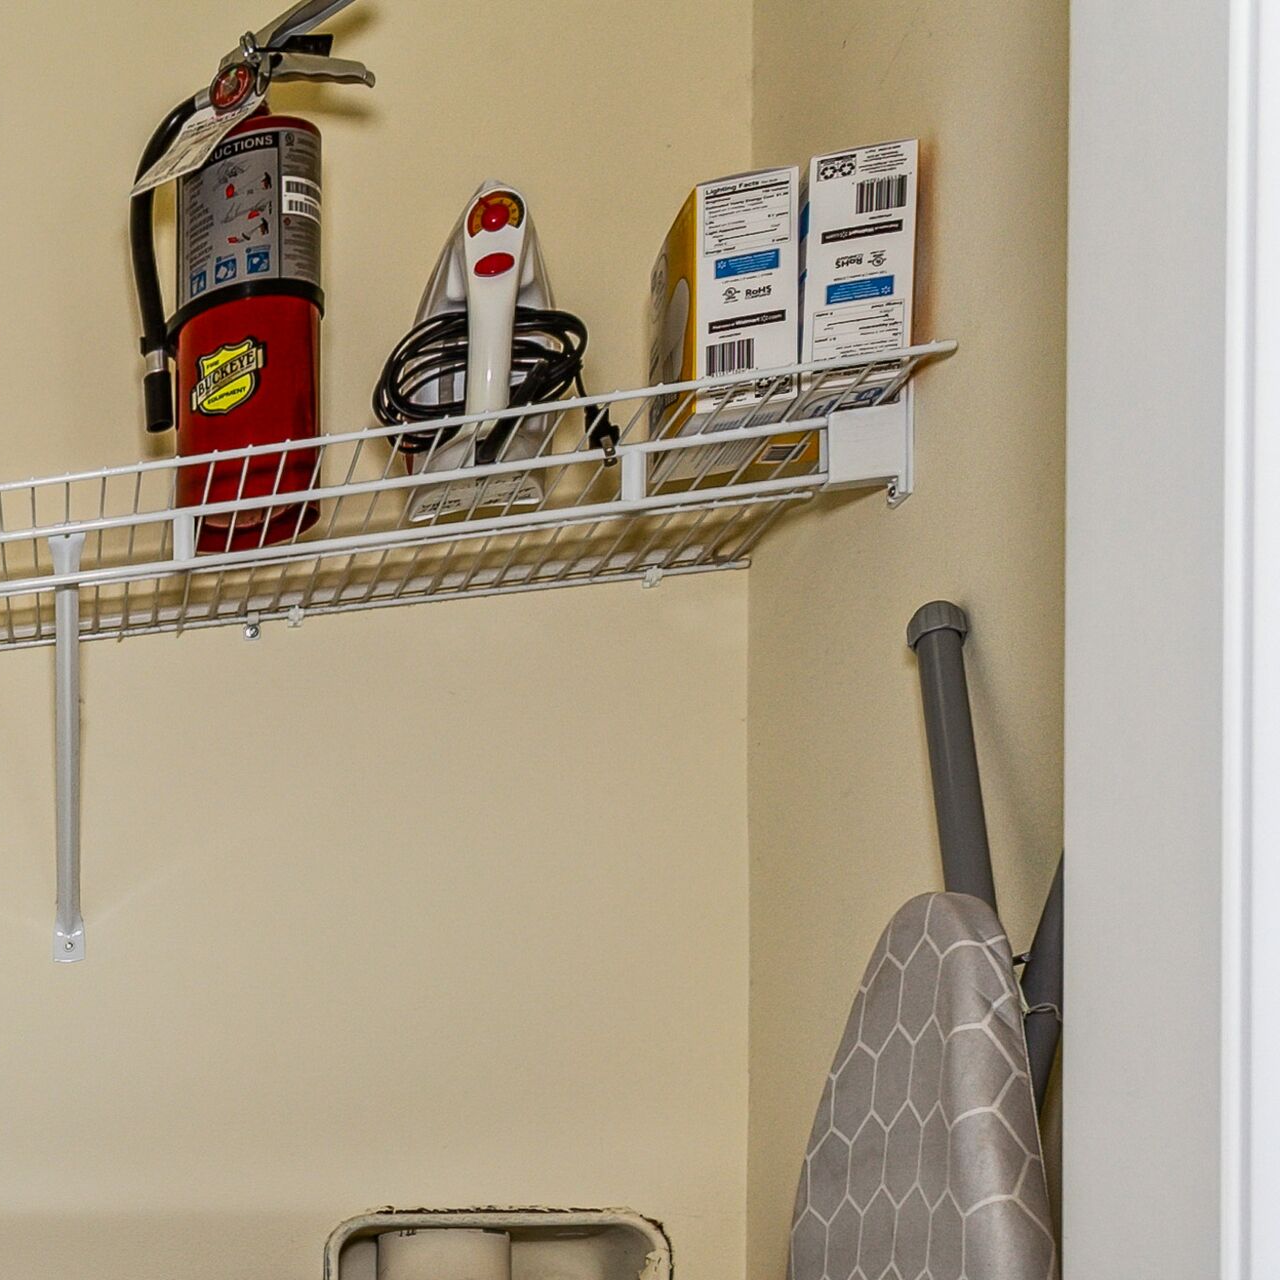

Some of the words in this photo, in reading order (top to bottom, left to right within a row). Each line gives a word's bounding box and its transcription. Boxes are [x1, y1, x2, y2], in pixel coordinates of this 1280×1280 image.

[210, 134, 273, 161] UCTIONS
[705, 184, 736, 195] Lighting
[835, 257, 863, 269] RoHS
[745, 285, 772, 297] RoHS
[198, 351, 254, 395] BUCKEYE
[208, 386, 246, 404] EQUIPMENT
